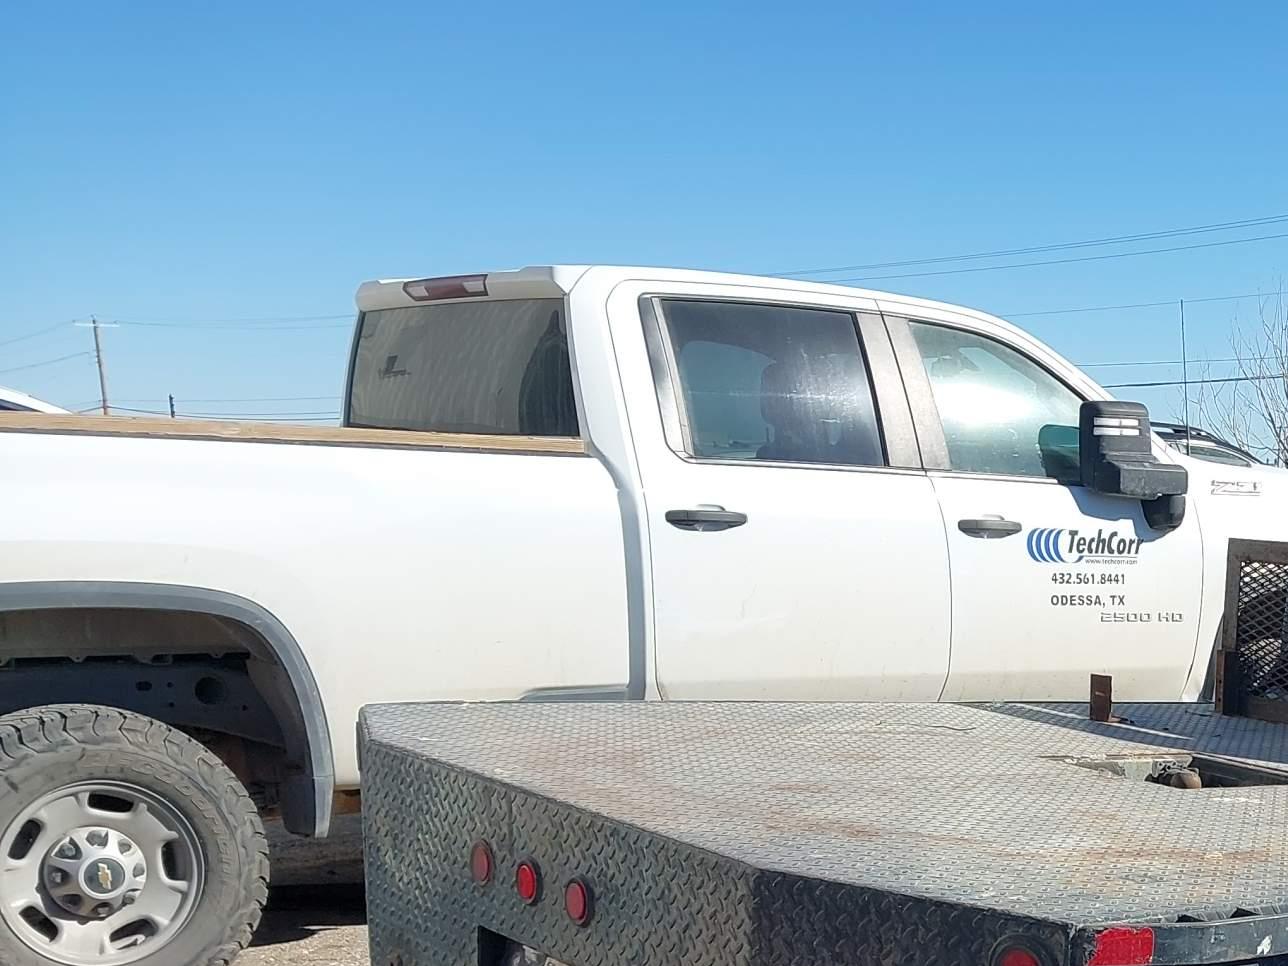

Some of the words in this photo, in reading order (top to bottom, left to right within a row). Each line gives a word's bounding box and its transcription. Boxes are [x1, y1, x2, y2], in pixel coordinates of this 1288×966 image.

[1068, 528, 1144, 555] TechCorr
[1051, 572, 1125, 585] 432.561.8441
[1050, 595, 1106, 608] ODESSA,
[1110, 595, 1125, 606] TX
[1100, 612, 1151, 622] 2500
[1157, 612, 1183, 622] HD
